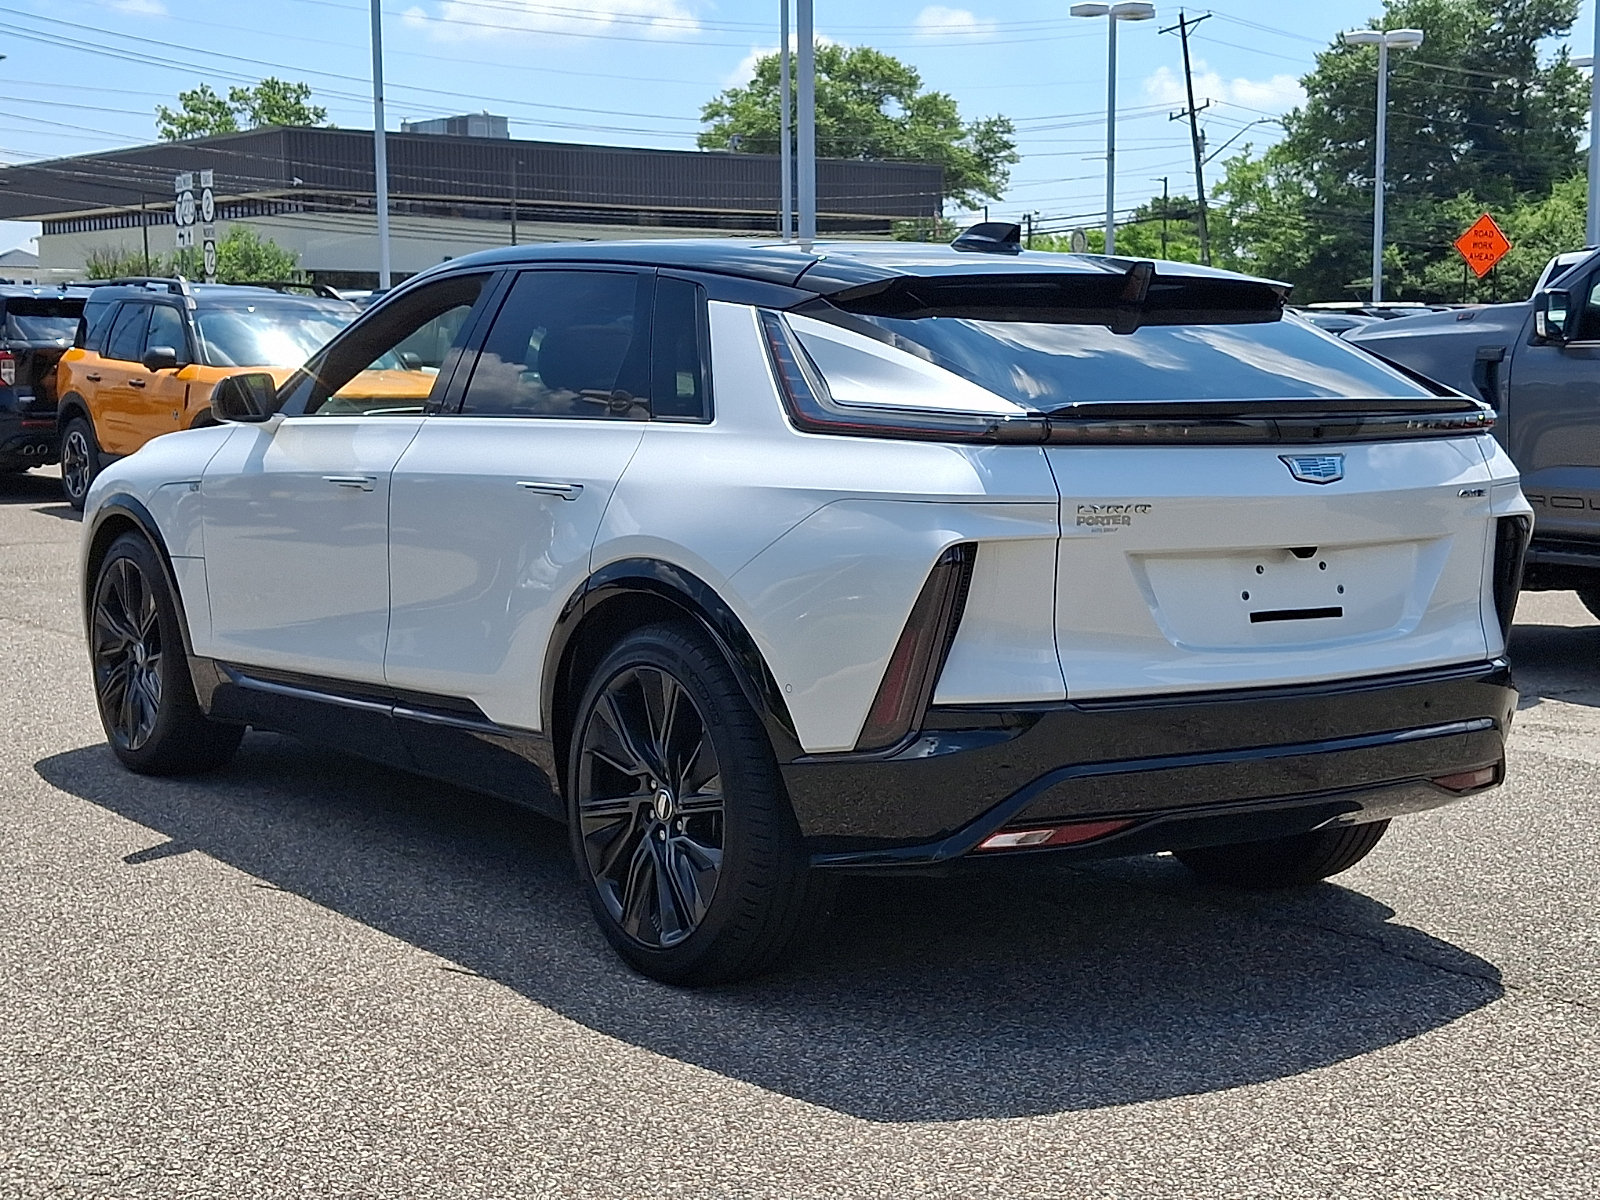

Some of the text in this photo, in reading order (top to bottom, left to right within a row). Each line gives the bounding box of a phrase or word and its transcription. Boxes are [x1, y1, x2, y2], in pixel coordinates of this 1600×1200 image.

[205, 196, 211, 214] 2
[1474, 230, 1494, 238] ROAD
[206, 249, 215, 267] 72
[1076, 515, 1131, 526] PORTER
